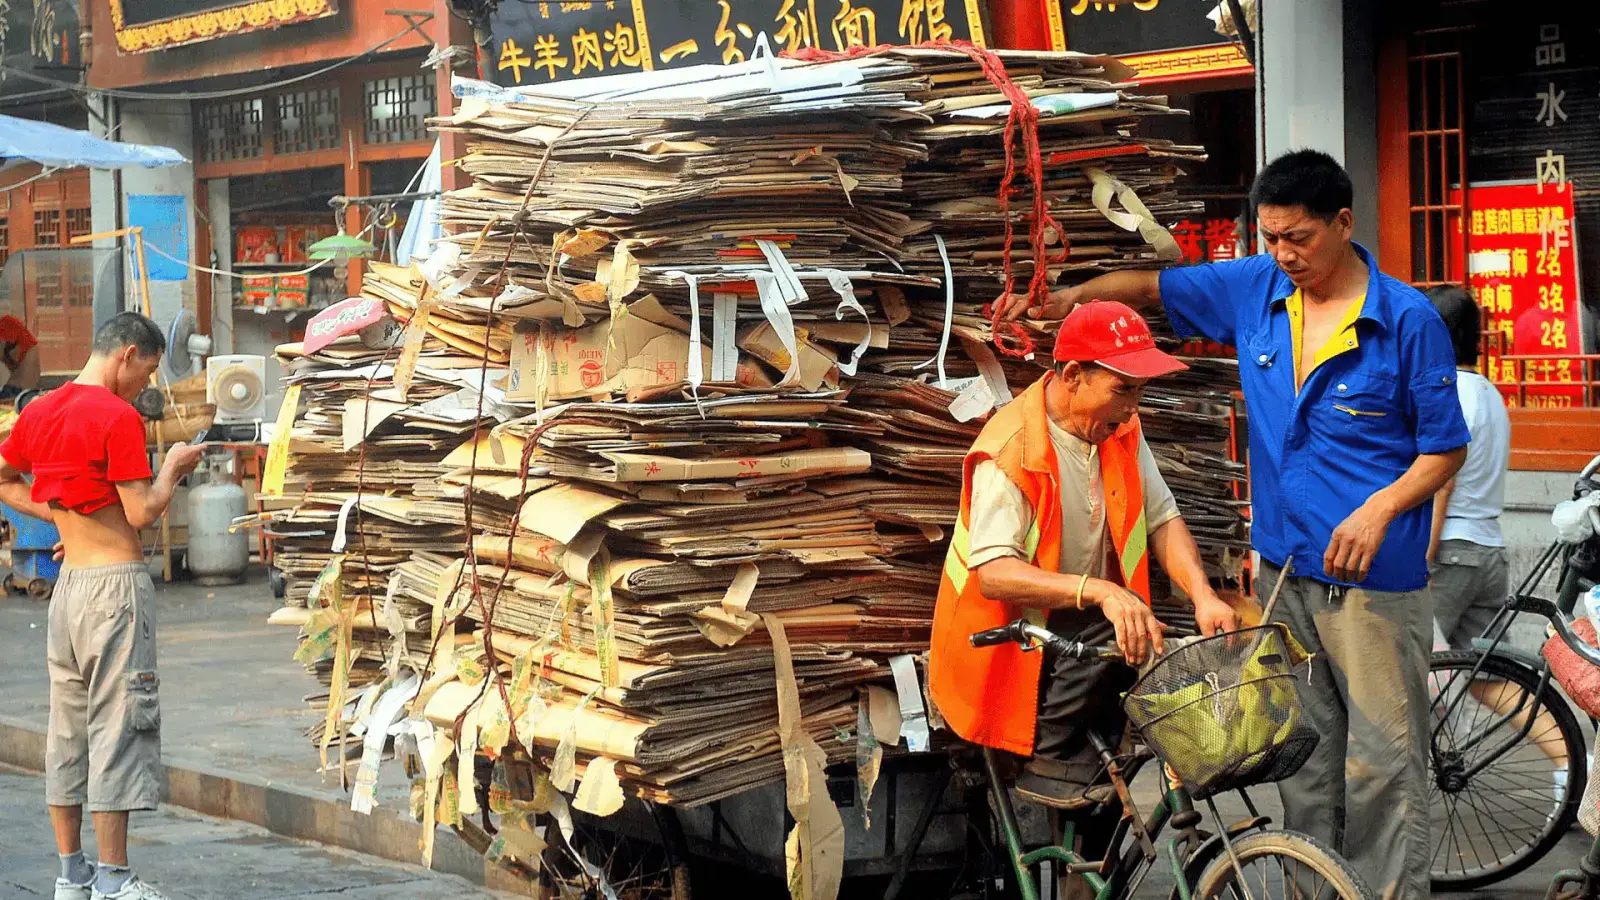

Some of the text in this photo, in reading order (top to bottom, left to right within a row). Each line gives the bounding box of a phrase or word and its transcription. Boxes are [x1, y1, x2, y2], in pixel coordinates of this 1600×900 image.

[498, 22, 642, 84] 牛羊肉泡
[1536, 246, 1562, 277] 2名
[1539, 282, 1564, 313] 3名
[1541, 318, 1567, 349] 2名
